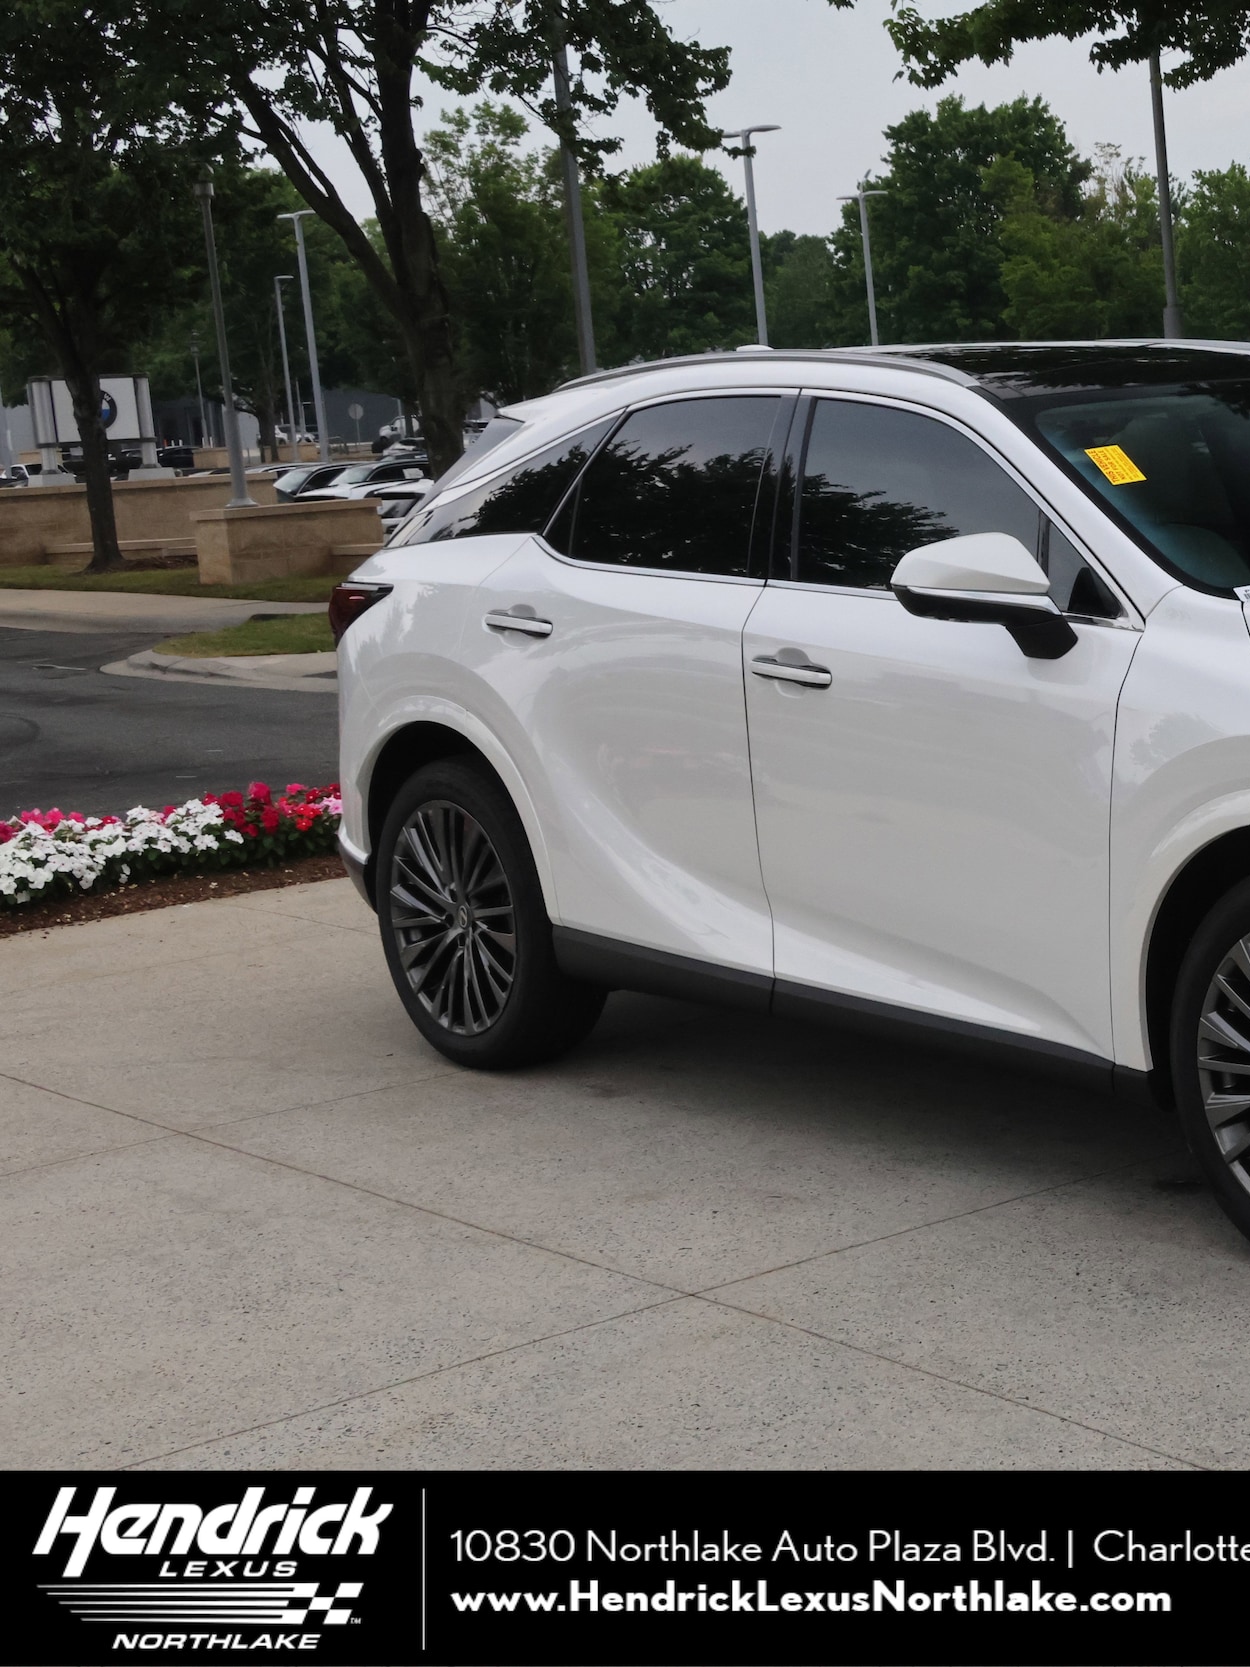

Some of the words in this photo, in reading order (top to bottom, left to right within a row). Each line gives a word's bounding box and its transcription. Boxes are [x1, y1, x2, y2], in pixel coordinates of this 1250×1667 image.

[1087, 450, 1109, 471] VEHICLE
[1097, 450, 1111, 462] SALE
[1107, 461, 1119, 471] FOR
[1105, 470, 1120, 483] THIS
